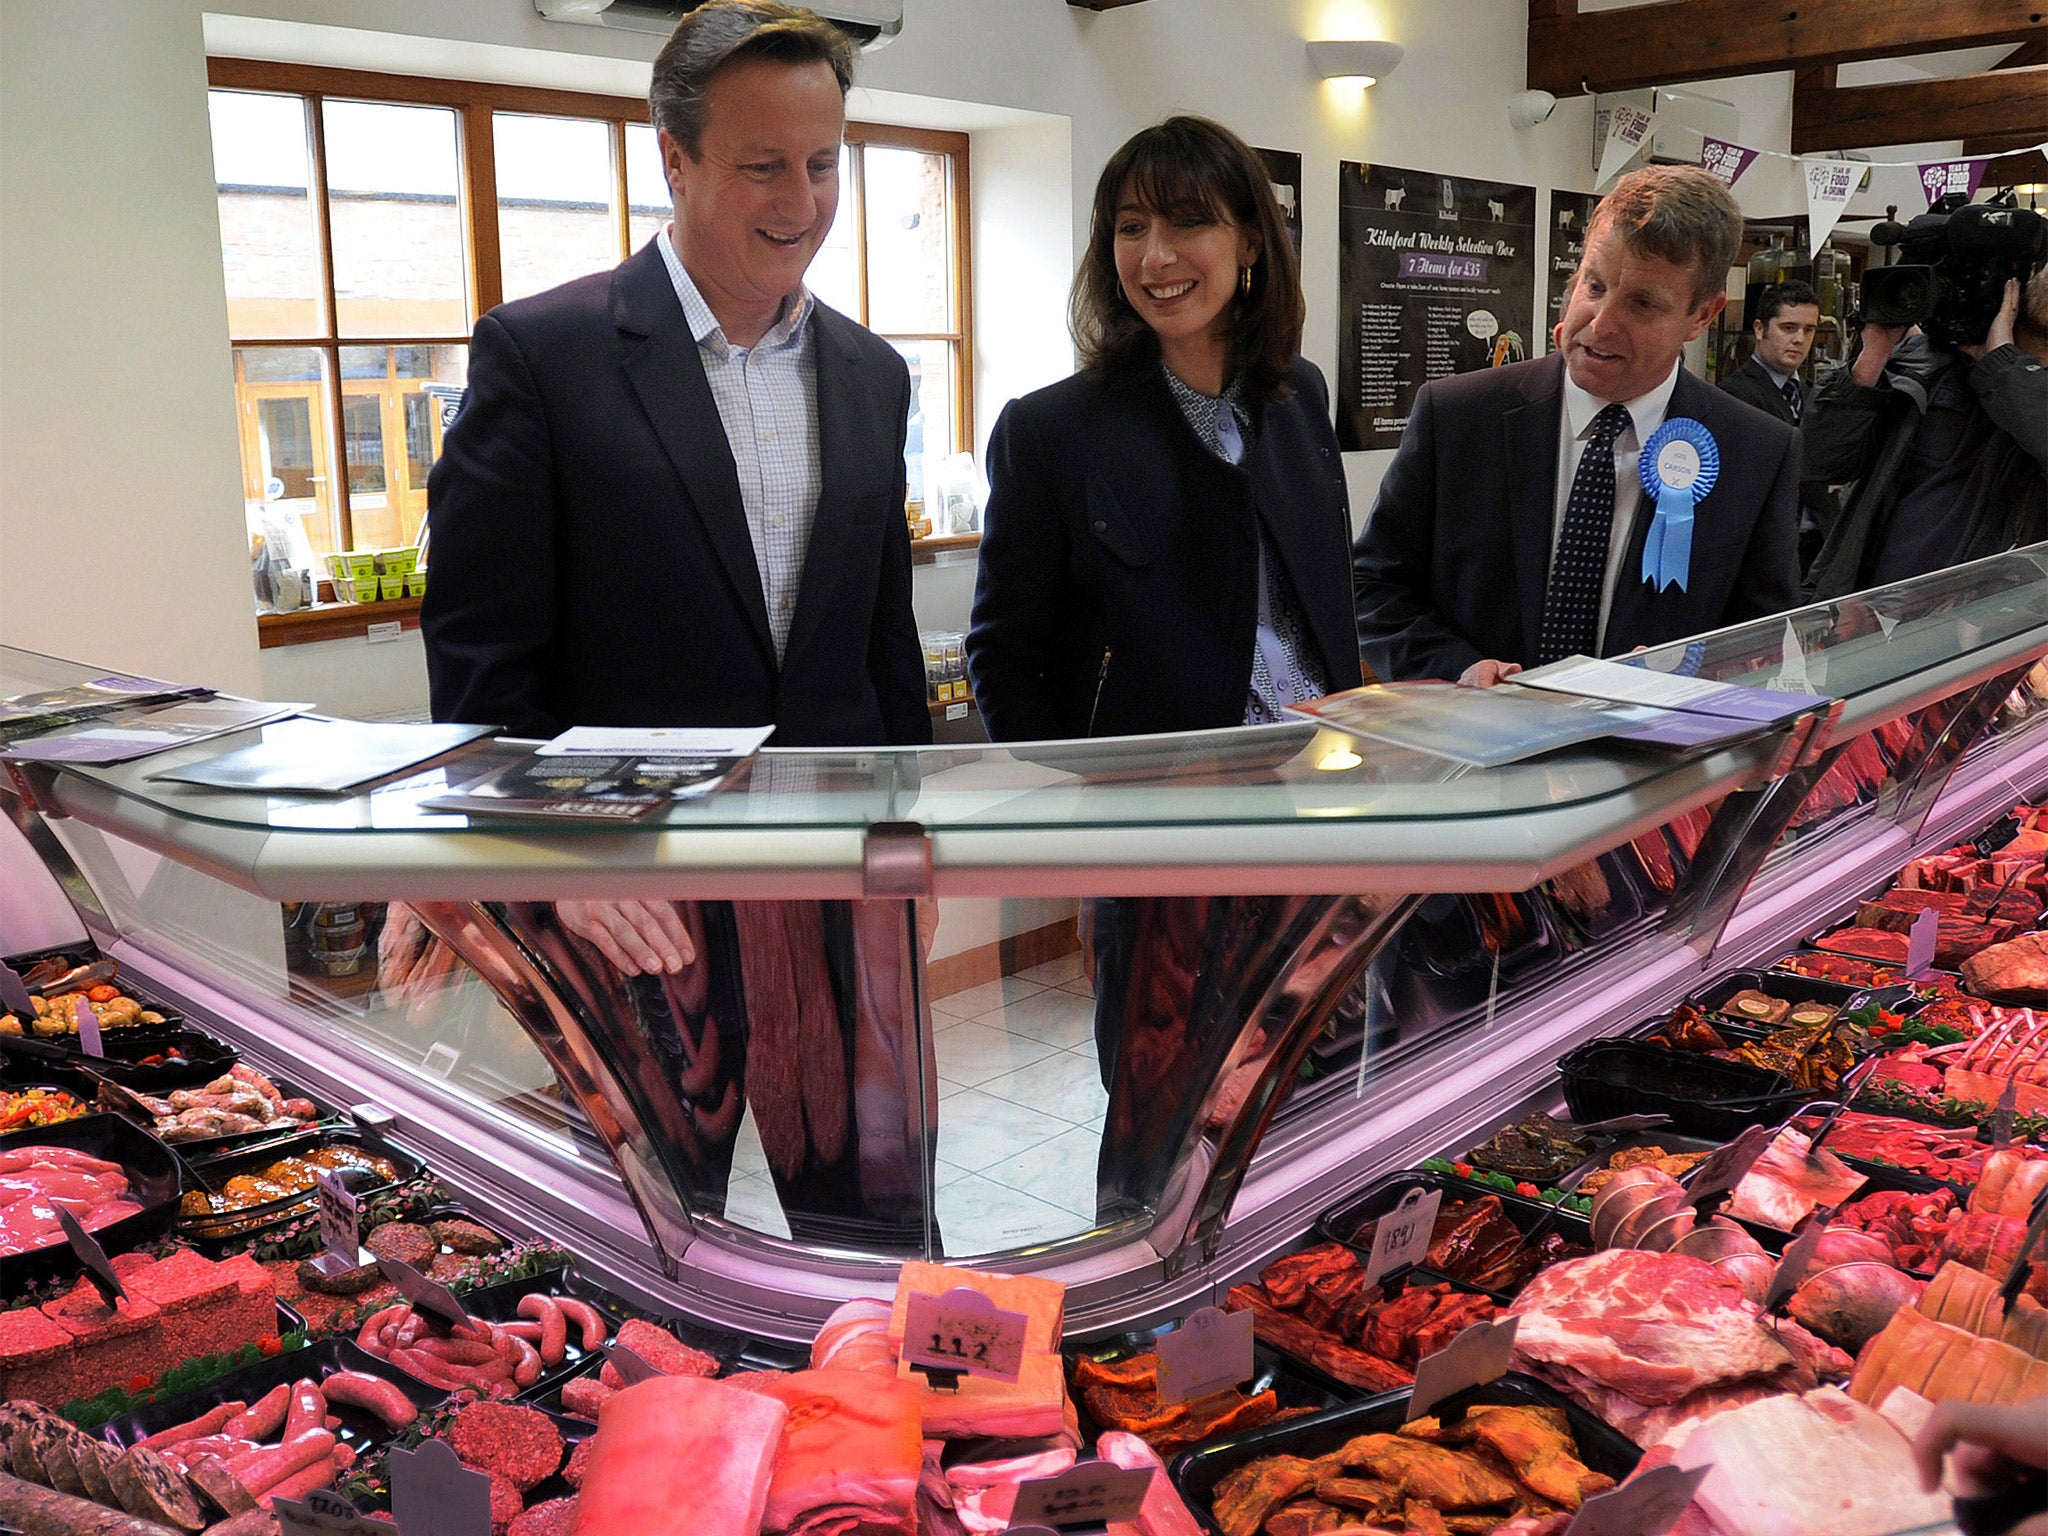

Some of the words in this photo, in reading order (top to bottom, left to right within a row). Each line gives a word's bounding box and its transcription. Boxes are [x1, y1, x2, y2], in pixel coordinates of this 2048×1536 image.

[1630, 118, 1648, 134] FOOD
[1830, 174, 1849, 186] FOOD
[1947, 172, 1970, 184] FOOD
[1364, 228, 1416, 250] Kilnford
[1419, 232, 1455, 255] Weekly
[1455, 236, 1494, 255] Selection
[1496, 241, 1515, 256] Box
[1408, 258, 1415, 272] 7
[1417, 257, 1446, 275] Items
[1447, 259, 1463, 278] for
[1463, 262, 1481, 277] £35
